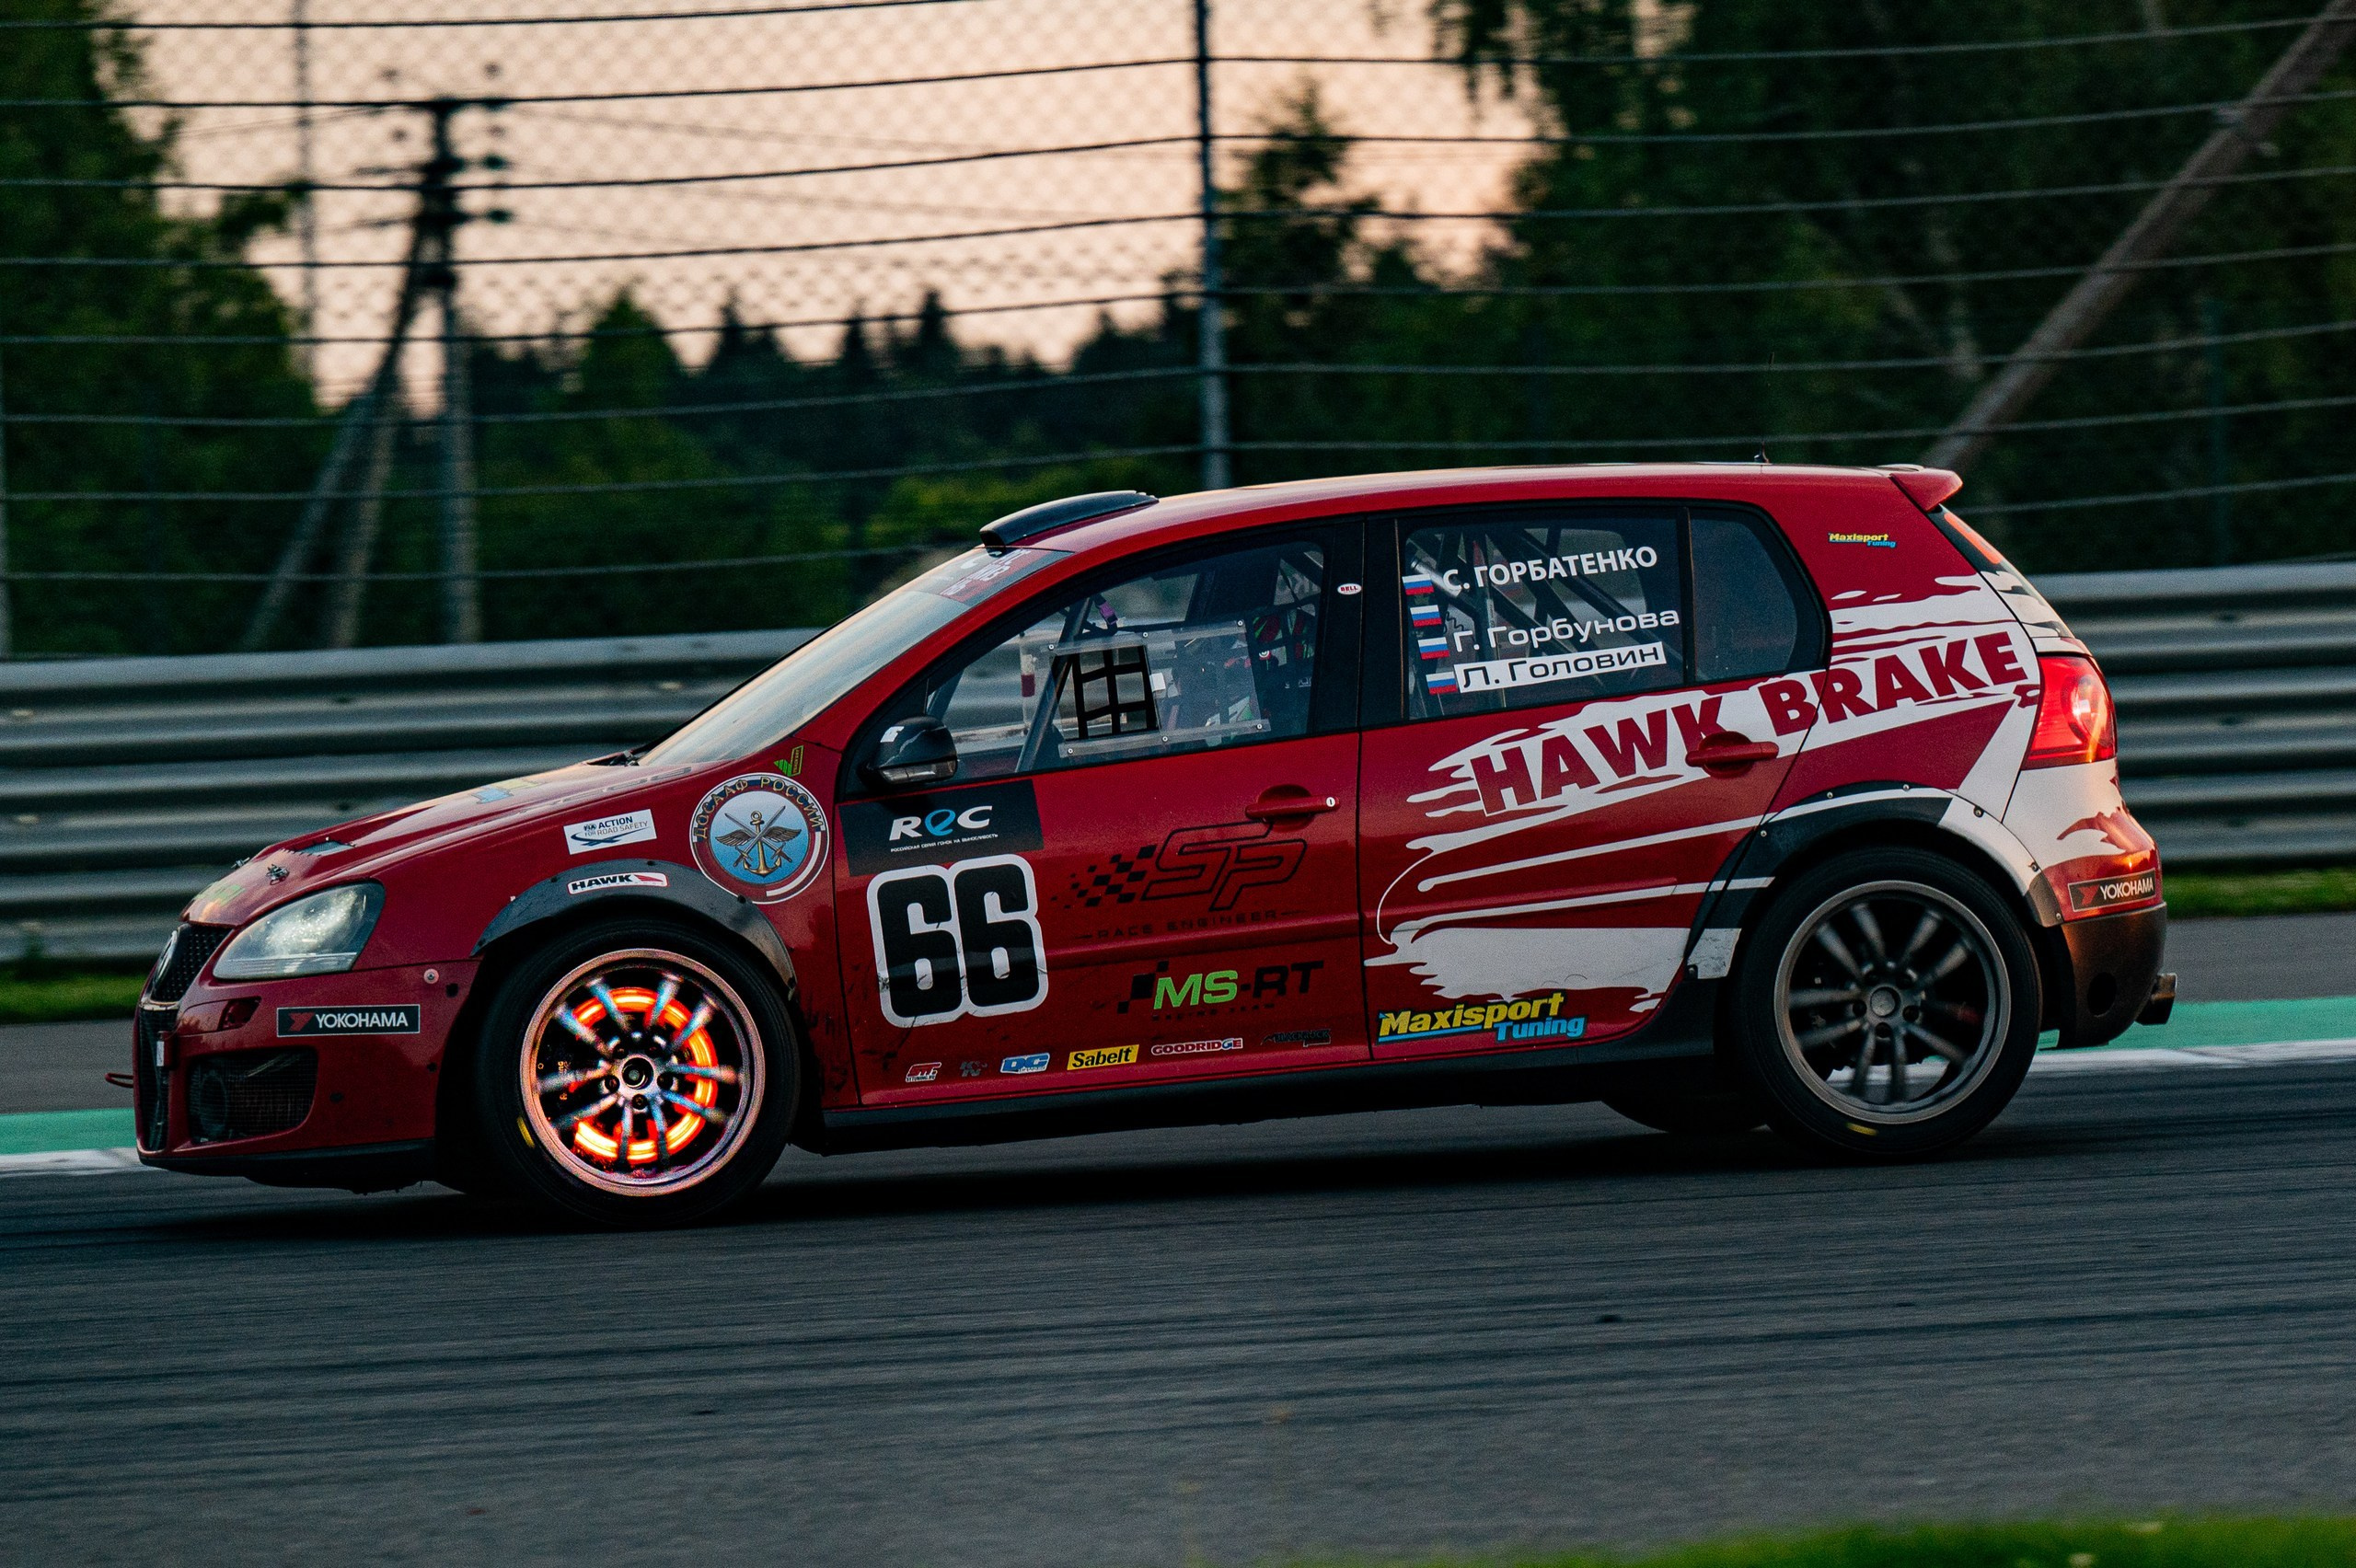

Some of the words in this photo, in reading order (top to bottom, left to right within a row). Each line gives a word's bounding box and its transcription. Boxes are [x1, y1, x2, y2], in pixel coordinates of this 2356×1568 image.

[1829, 533, 1888, 543] Maxisport
[1442, 568, 1472, 591] С.
[1473, 546, 1657, 588] ГОРБАТЕНКО
[1453, 629, 1480, 652] Г.
[1487, 609, 1680, 649] Горбунова
[1463, 665, 1501, 688] Л.
[1507, 646, 1660, 681] Головин
[1470, 695, 1727, 816] HAWK
[1758, 631, 2028, 737] BRAKE
[693, 779, 748, 839] ДОСААФ
[760, 776, 825, 828] РОССИИ
[597, 826, 618, 836] ROAD
[620, 821, 648, 832] SAFETY
[598, 815, 633, 829] ACTION
[1141, 817, 1308, 912] SP
[571, 874, 633, 891] HAWK
[2098, 876, 2154, 902] YOKOHAMA
[1097, 923, 1154, 940] RACE
[1167, 909, 1277, 931] ENGINEER
[872, 859, 1044, 1021] 66
[315, 1011, 409, 1030] YOKOHAMA
[1379, 992, 1565, 1037] Maxisport
[1494, 1016, 1586, 1042] Tuning
[1071, 1047, 1132, 1068] Sabelt
[1151, 1038, 1242, 1055] GOODRIDGE
